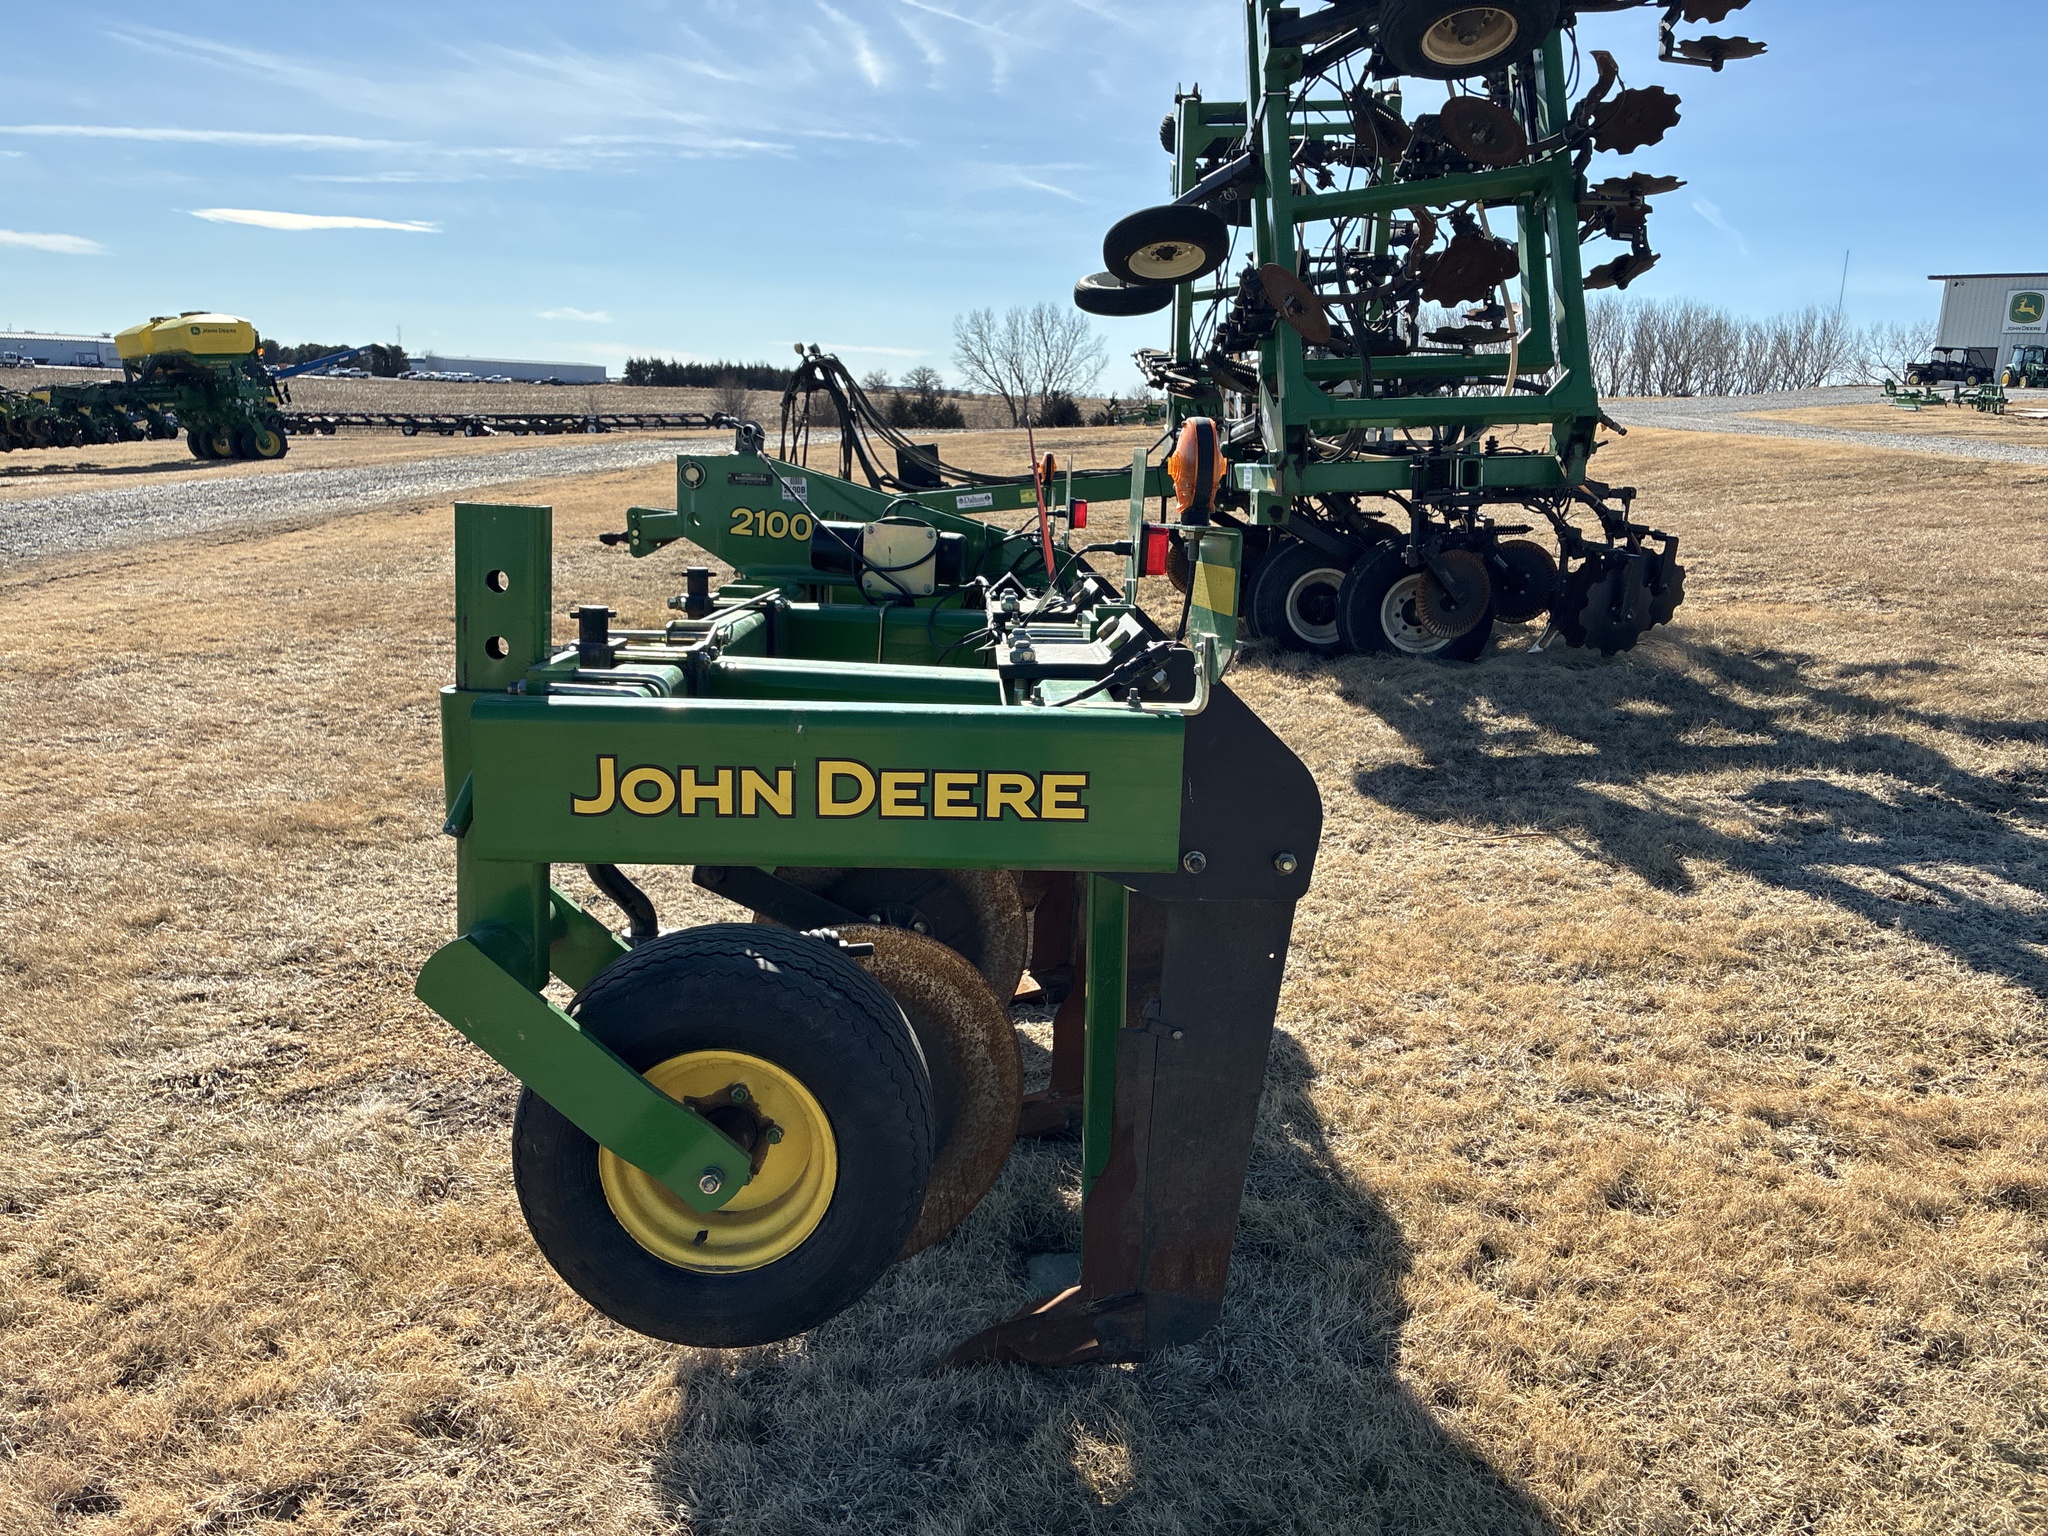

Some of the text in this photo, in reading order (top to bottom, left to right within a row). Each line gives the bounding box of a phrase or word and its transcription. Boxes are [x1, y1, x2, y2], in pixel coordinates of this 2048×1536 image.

[783, 485, 806, 494] 200B
[730, 507, 813, 542] 2100
[571, 754, 1091, 822] JOHN DEERE
